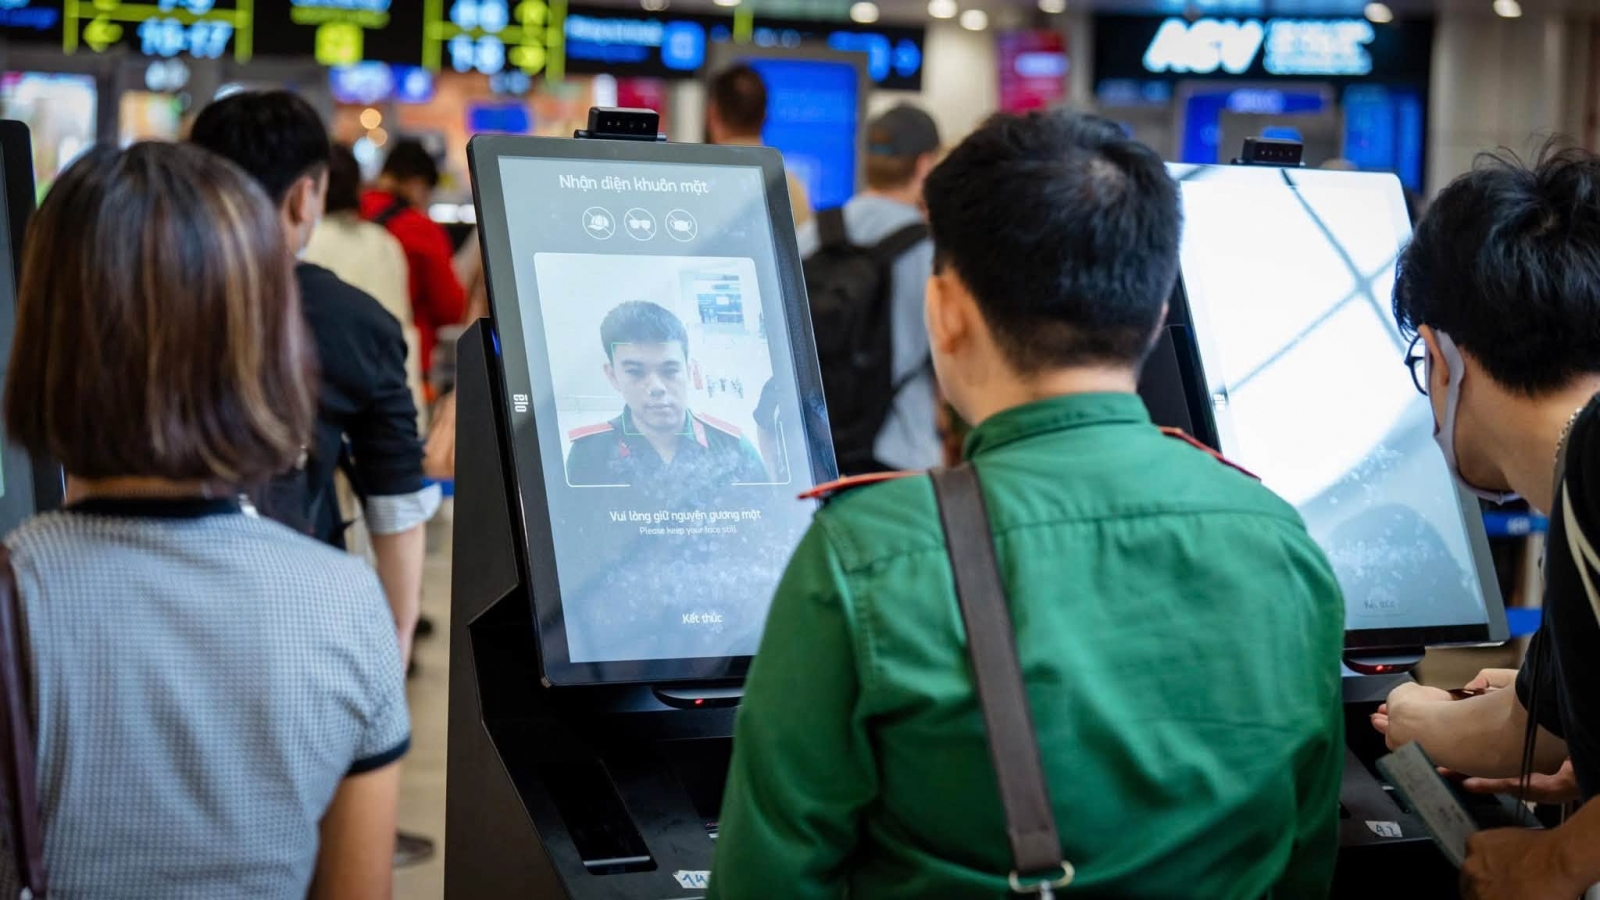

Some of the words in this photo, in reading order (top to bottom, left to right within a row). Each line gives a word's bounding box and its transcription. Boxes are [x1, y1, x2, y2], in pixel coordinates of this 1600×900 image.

[558, 174, 597, 192] Nhận
[601, 176, 631, 193] diện
[633, 176, 677, 193] khuôn
[680, 179, 710, 196] mặt
[609, 510, 627, 522] Vui
[628, 510, 652, 524] lòng
[653, 510, 669, 524] giữ
[671, 510, 707, 523] nguyên
[639, 526, 665, 536] Please
[666, 526, 685, 536] keep
[686, 527, 703, 536] your
[704, 525, 721, 534] face
[682, 612, 700, 624] Kết
[701, 612, 723, 623] thúc
